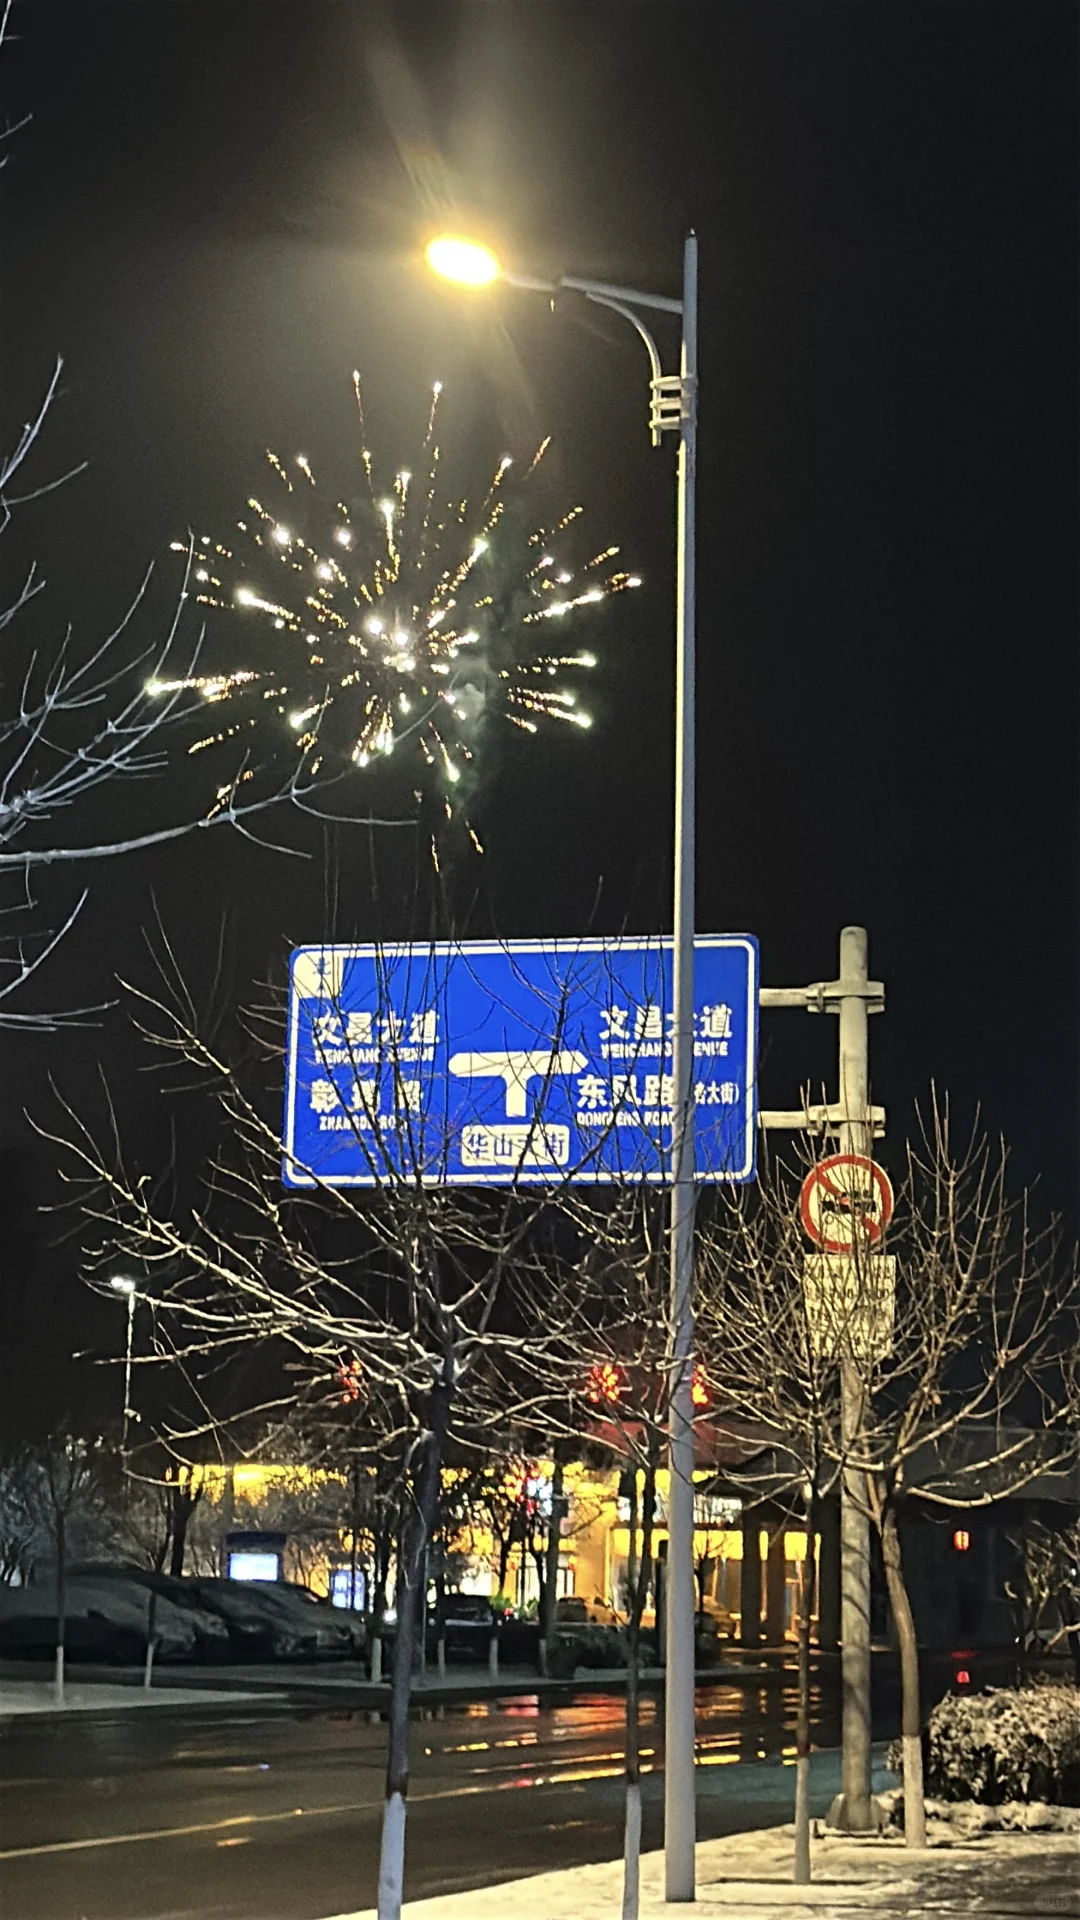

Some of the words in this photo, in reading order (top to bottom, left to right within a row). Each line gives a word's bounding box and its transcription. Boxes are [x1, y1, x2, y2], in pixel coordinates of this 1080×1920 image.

[693, 1041, 729, 1057] ENUE
[577, 1074, 676, 1109] 东风路
[468, 1132, 565, 1158] 华山街
